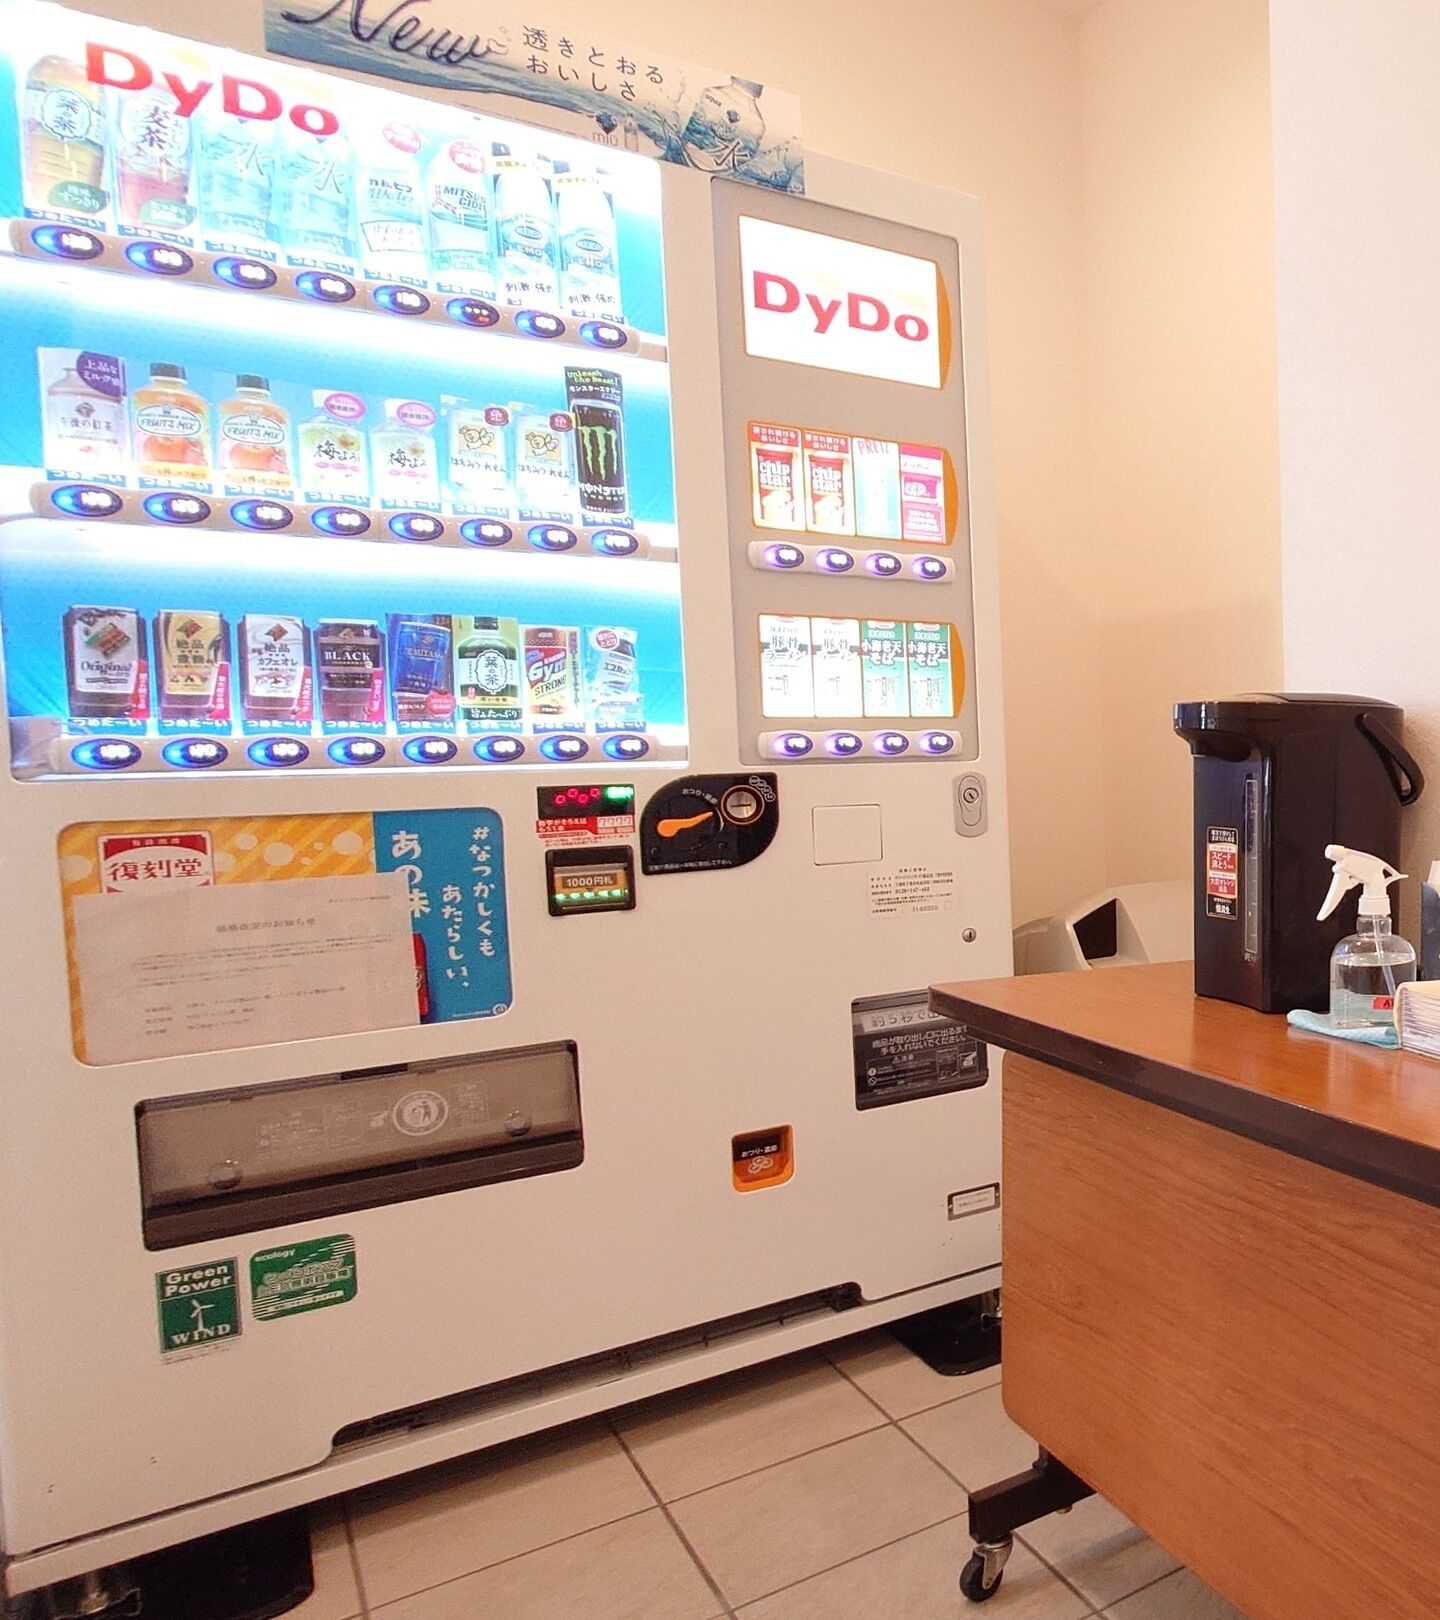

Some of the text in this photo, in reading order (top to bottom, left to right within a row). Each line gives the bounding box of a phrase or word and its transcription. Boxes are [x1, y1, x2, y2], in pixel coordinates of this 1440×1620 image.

[522, 25, 665, 85] 透きとおる
[86, 41, 340, 136] DyDo
[526, 55, 637, 101] おいしさ
[753, 270, 929, 342] DyDo
[759, 460, 791, 475] chip
[812, 466, 842, 481] chip
[759, 473, 791, 487] star
[812, 478, 842, 493] star
[257, 656, 298, 667] カフェオレ
[325, 651, 371, 661] BLACK
[484, 655, 499, 686] 葉の茶
[535, 674, 568, 697] STRONG
[107, 857, 206, 882] 復刻堂
[567, 875, 614, 887] 1000円札
[254, 1249, 296, 1262] ecology
[166, 1264, 229, 1285] Green
[165, 1276, 231, 1297] Power
[171, 1323, 232, 1345] WIND
